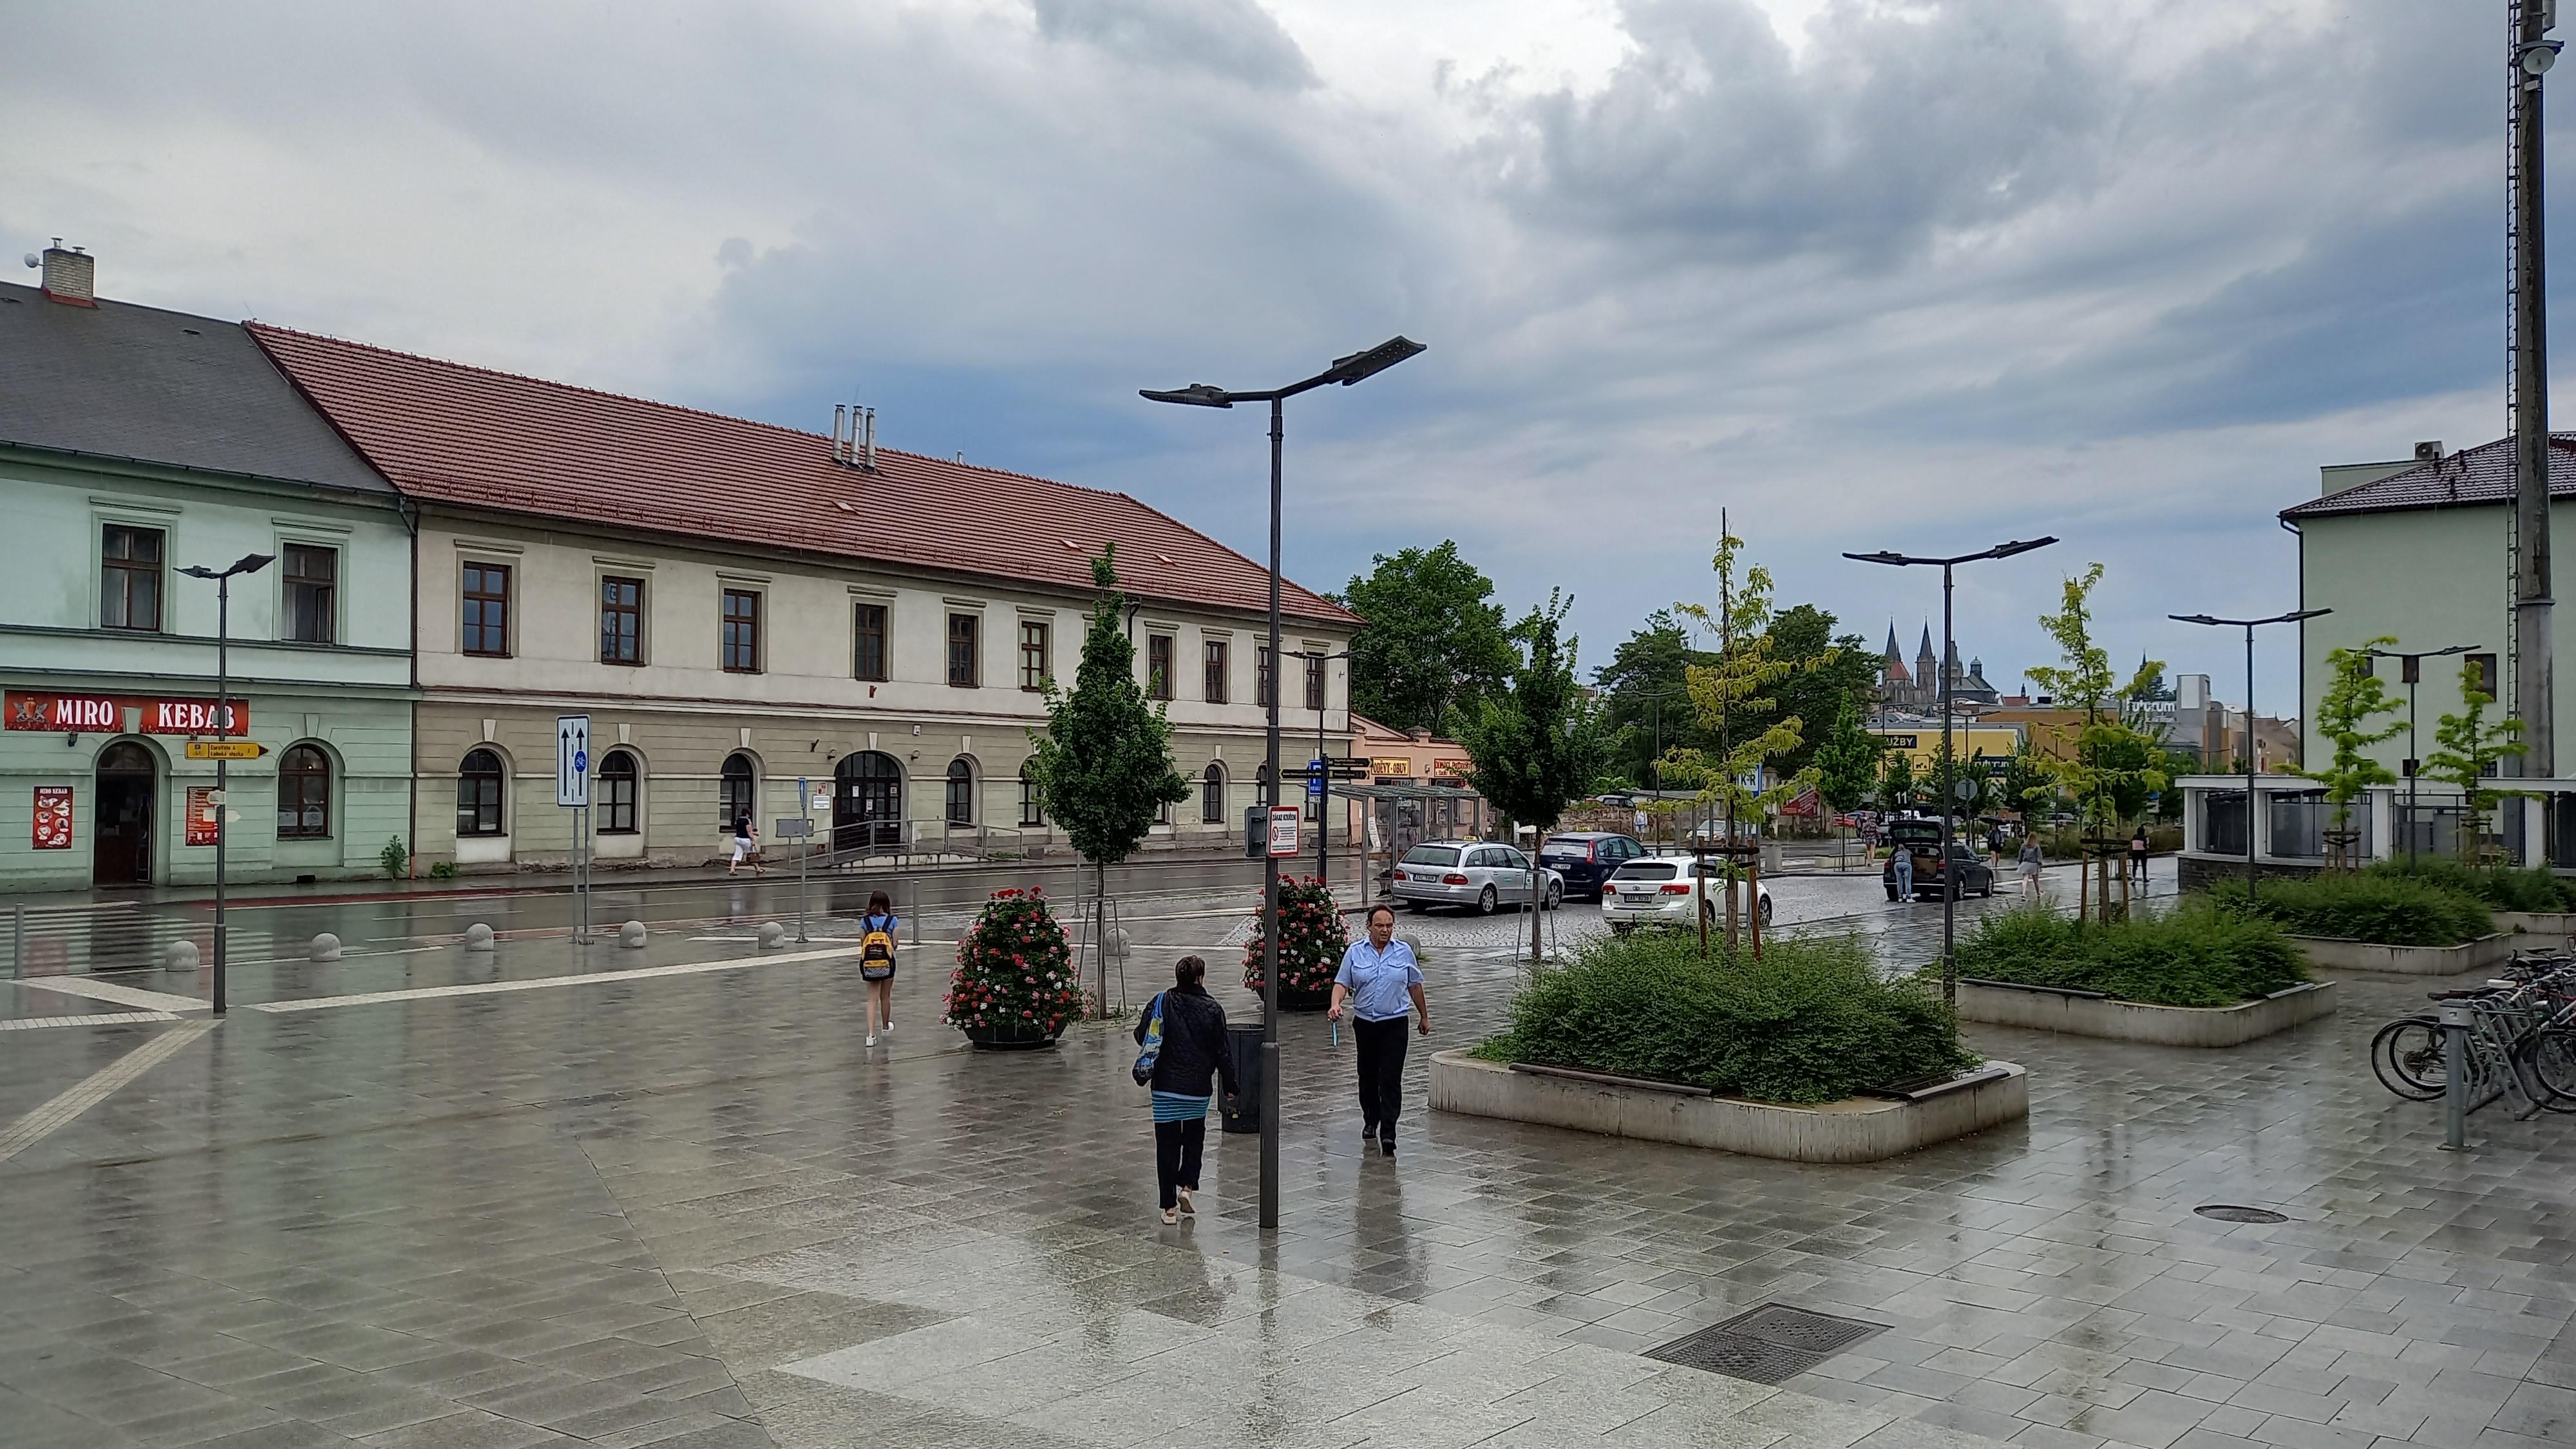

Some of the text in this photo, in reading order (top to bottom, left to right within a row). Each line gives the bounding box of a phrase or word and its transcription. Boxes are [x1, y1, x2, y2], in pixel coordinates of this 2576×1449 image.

[55, 699, 235, 729] MIRO KEBAB
[1373, 760, 1407, 773] ODĚVY OBUV
[1741, 773, 1756, 786] K+R
[1895, 791, 1908, 804] 11
